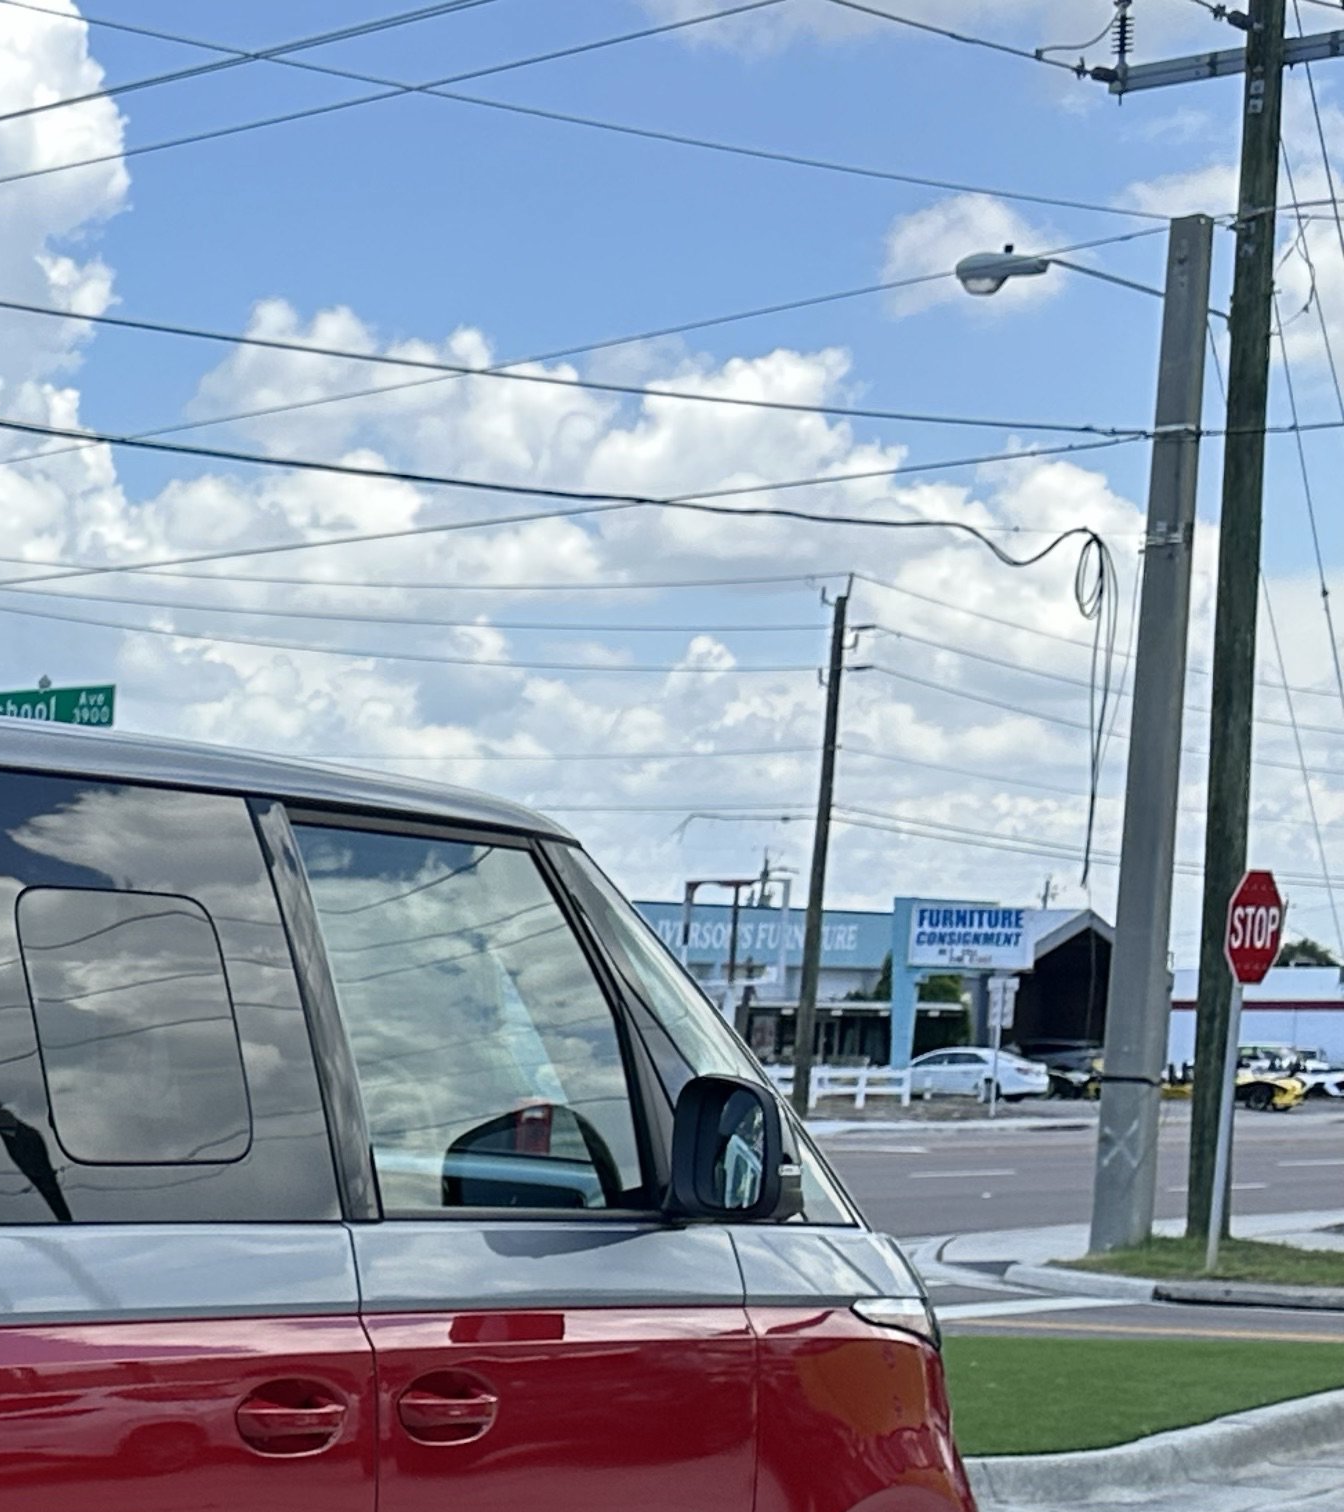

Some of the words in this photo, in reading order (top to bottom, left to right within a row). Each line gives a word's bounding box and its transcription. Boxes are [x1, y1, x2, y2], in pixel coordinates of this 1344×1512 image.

[79, 691, 105, 705] Ave
[917, 908, 1025, 928] FURNITURE
[1230, 906, 1280, 949] STOP
[756, 922, 859, 951] FURNURE
[915, 931, 1022, 947] CONSIGNMENT
